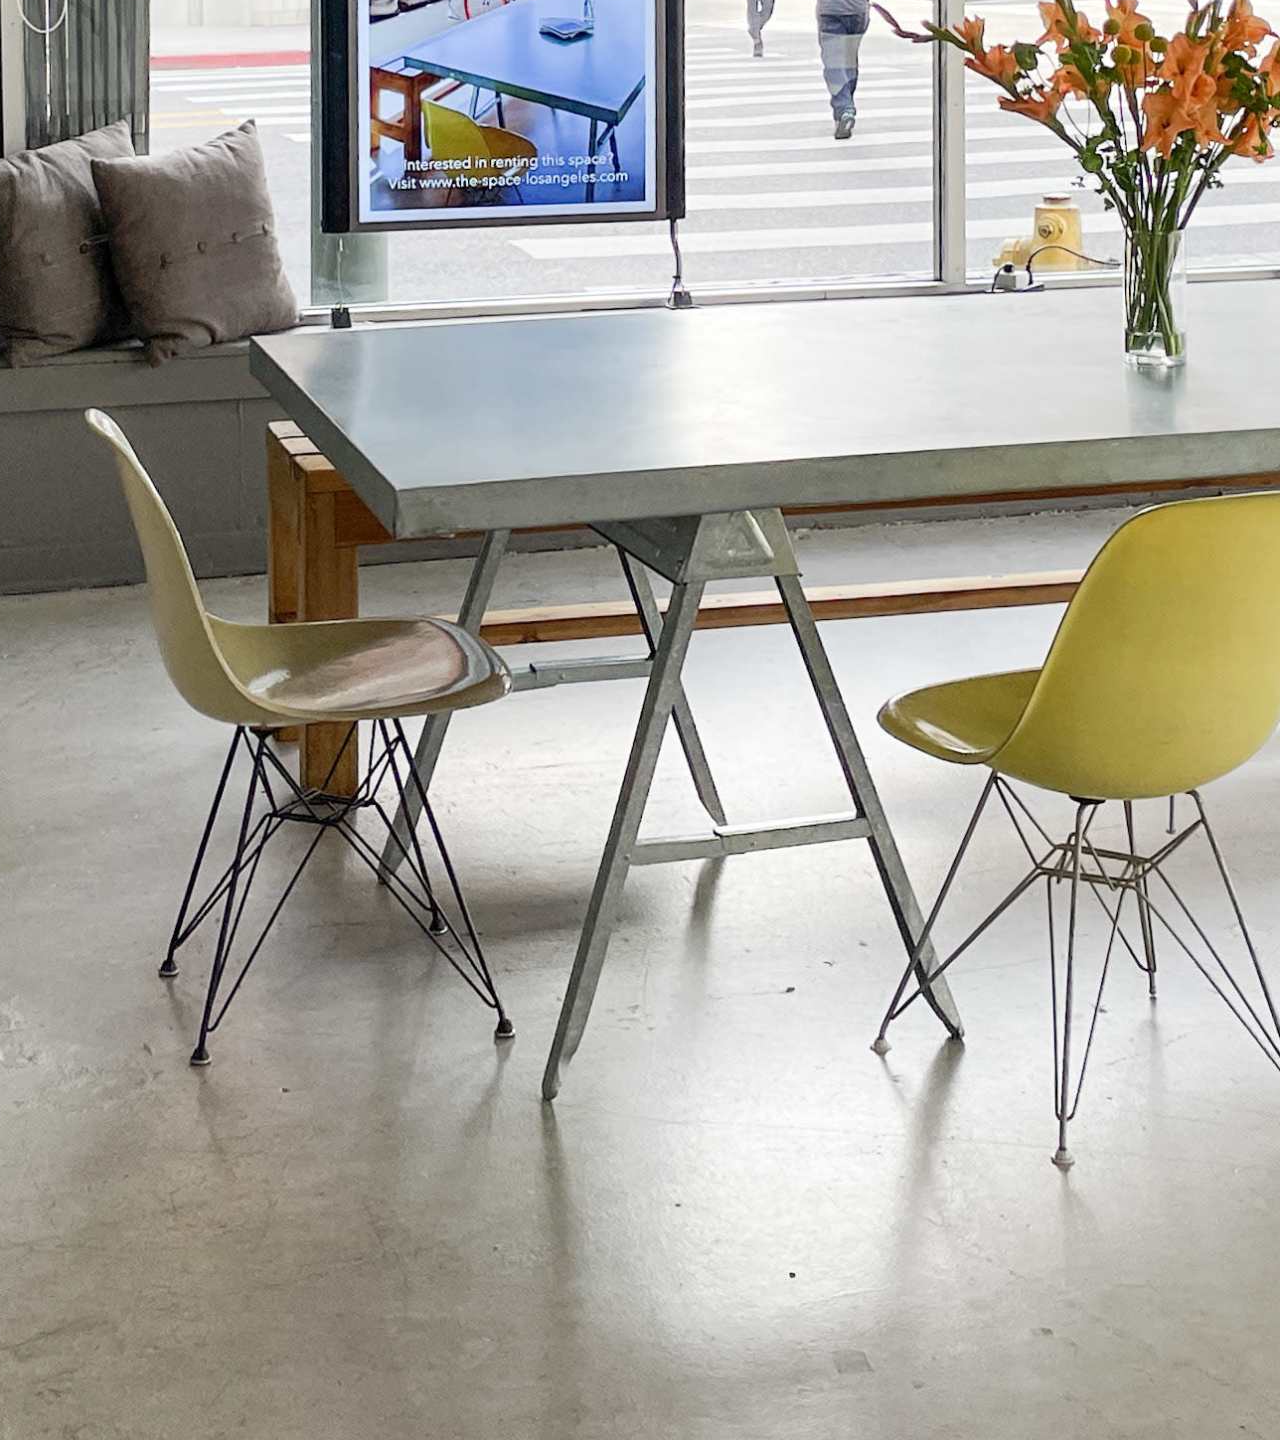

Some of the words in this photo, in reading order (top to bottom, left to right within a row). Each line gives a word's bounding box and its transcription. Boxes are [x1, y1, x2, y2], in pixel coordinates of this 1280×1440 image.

[404, 156, 471, 172] Interested
[475, 156, 487, 170] in
[491, 155, 537, 171] renting
[542, 153, 565, 167] this
[567, 152, 615, 168] space?
[388, 176, 417, 190] Visit
[419, 170, 629, 190] www.the-space-losangeles.com
